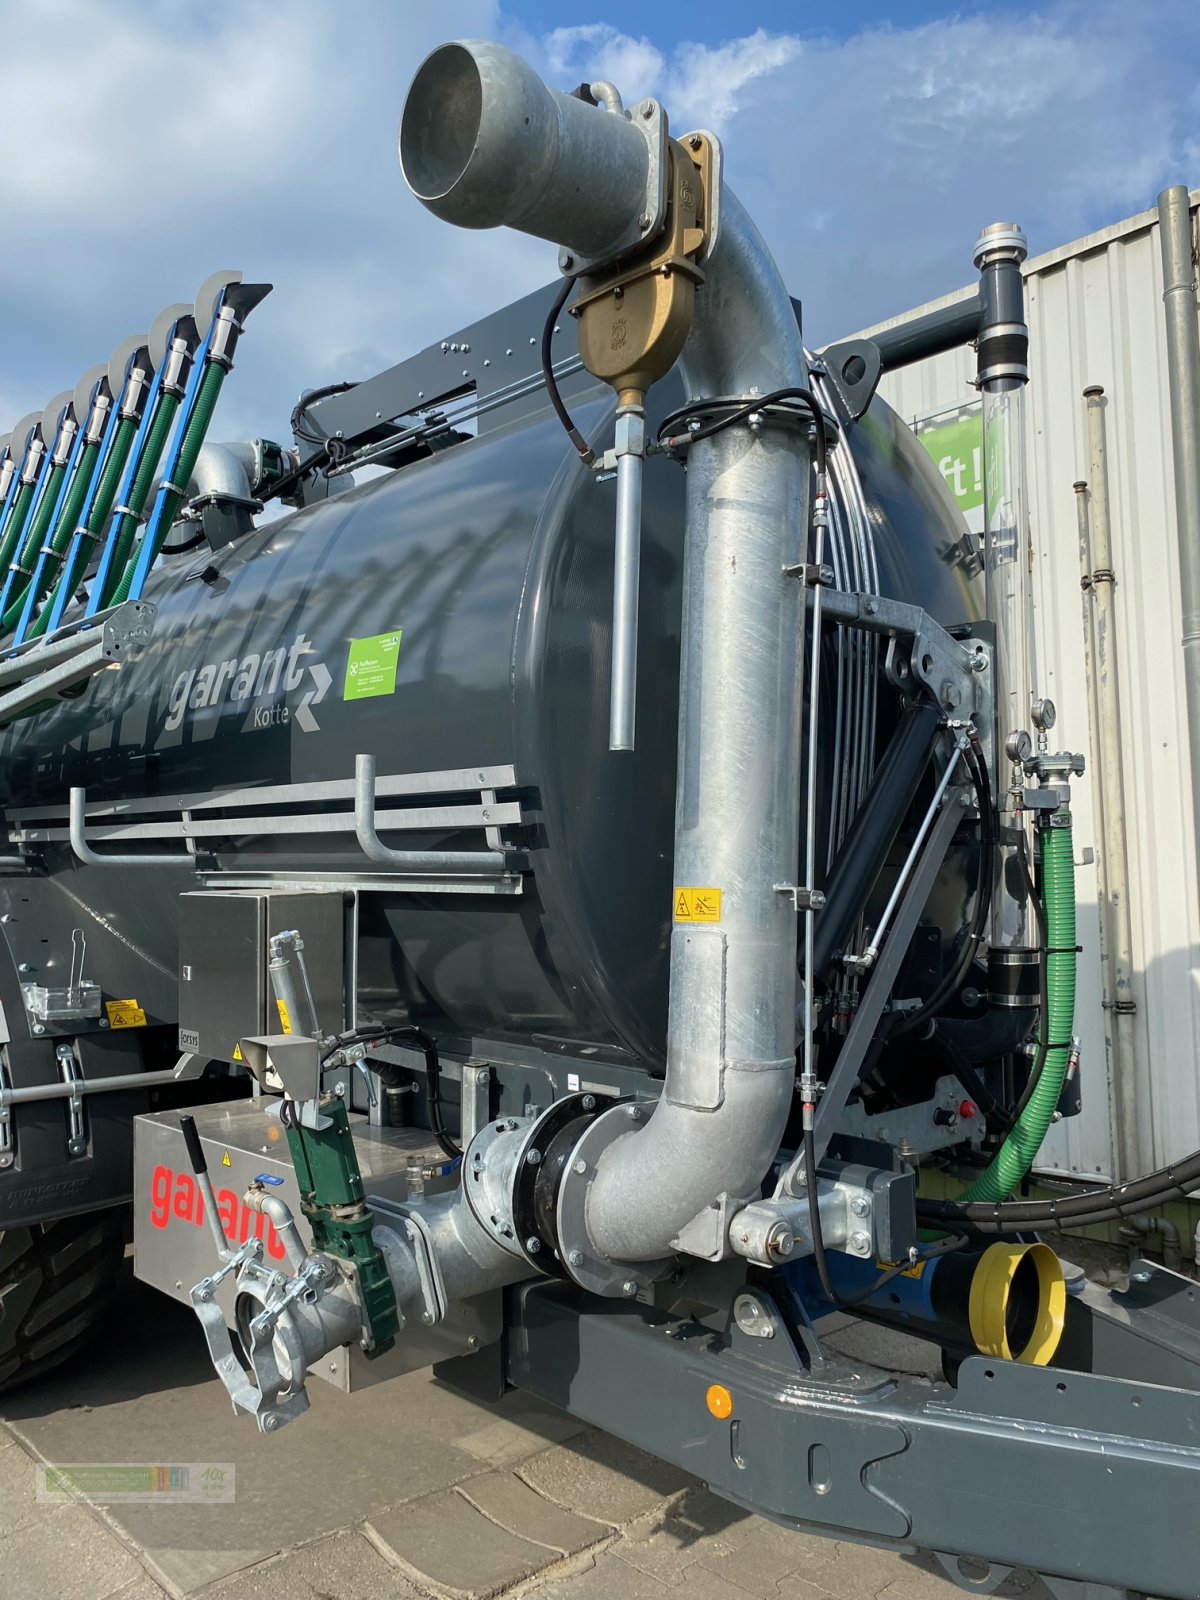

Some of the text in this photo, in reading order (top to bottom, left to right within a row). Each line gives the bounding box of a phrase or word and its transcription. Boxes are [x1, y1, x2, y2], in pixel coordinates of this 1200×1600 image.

[164, 633, 312, 731] garant
[253, 706, 289, 727] Kotte
[180, 1030, 198, 1047] forsys
